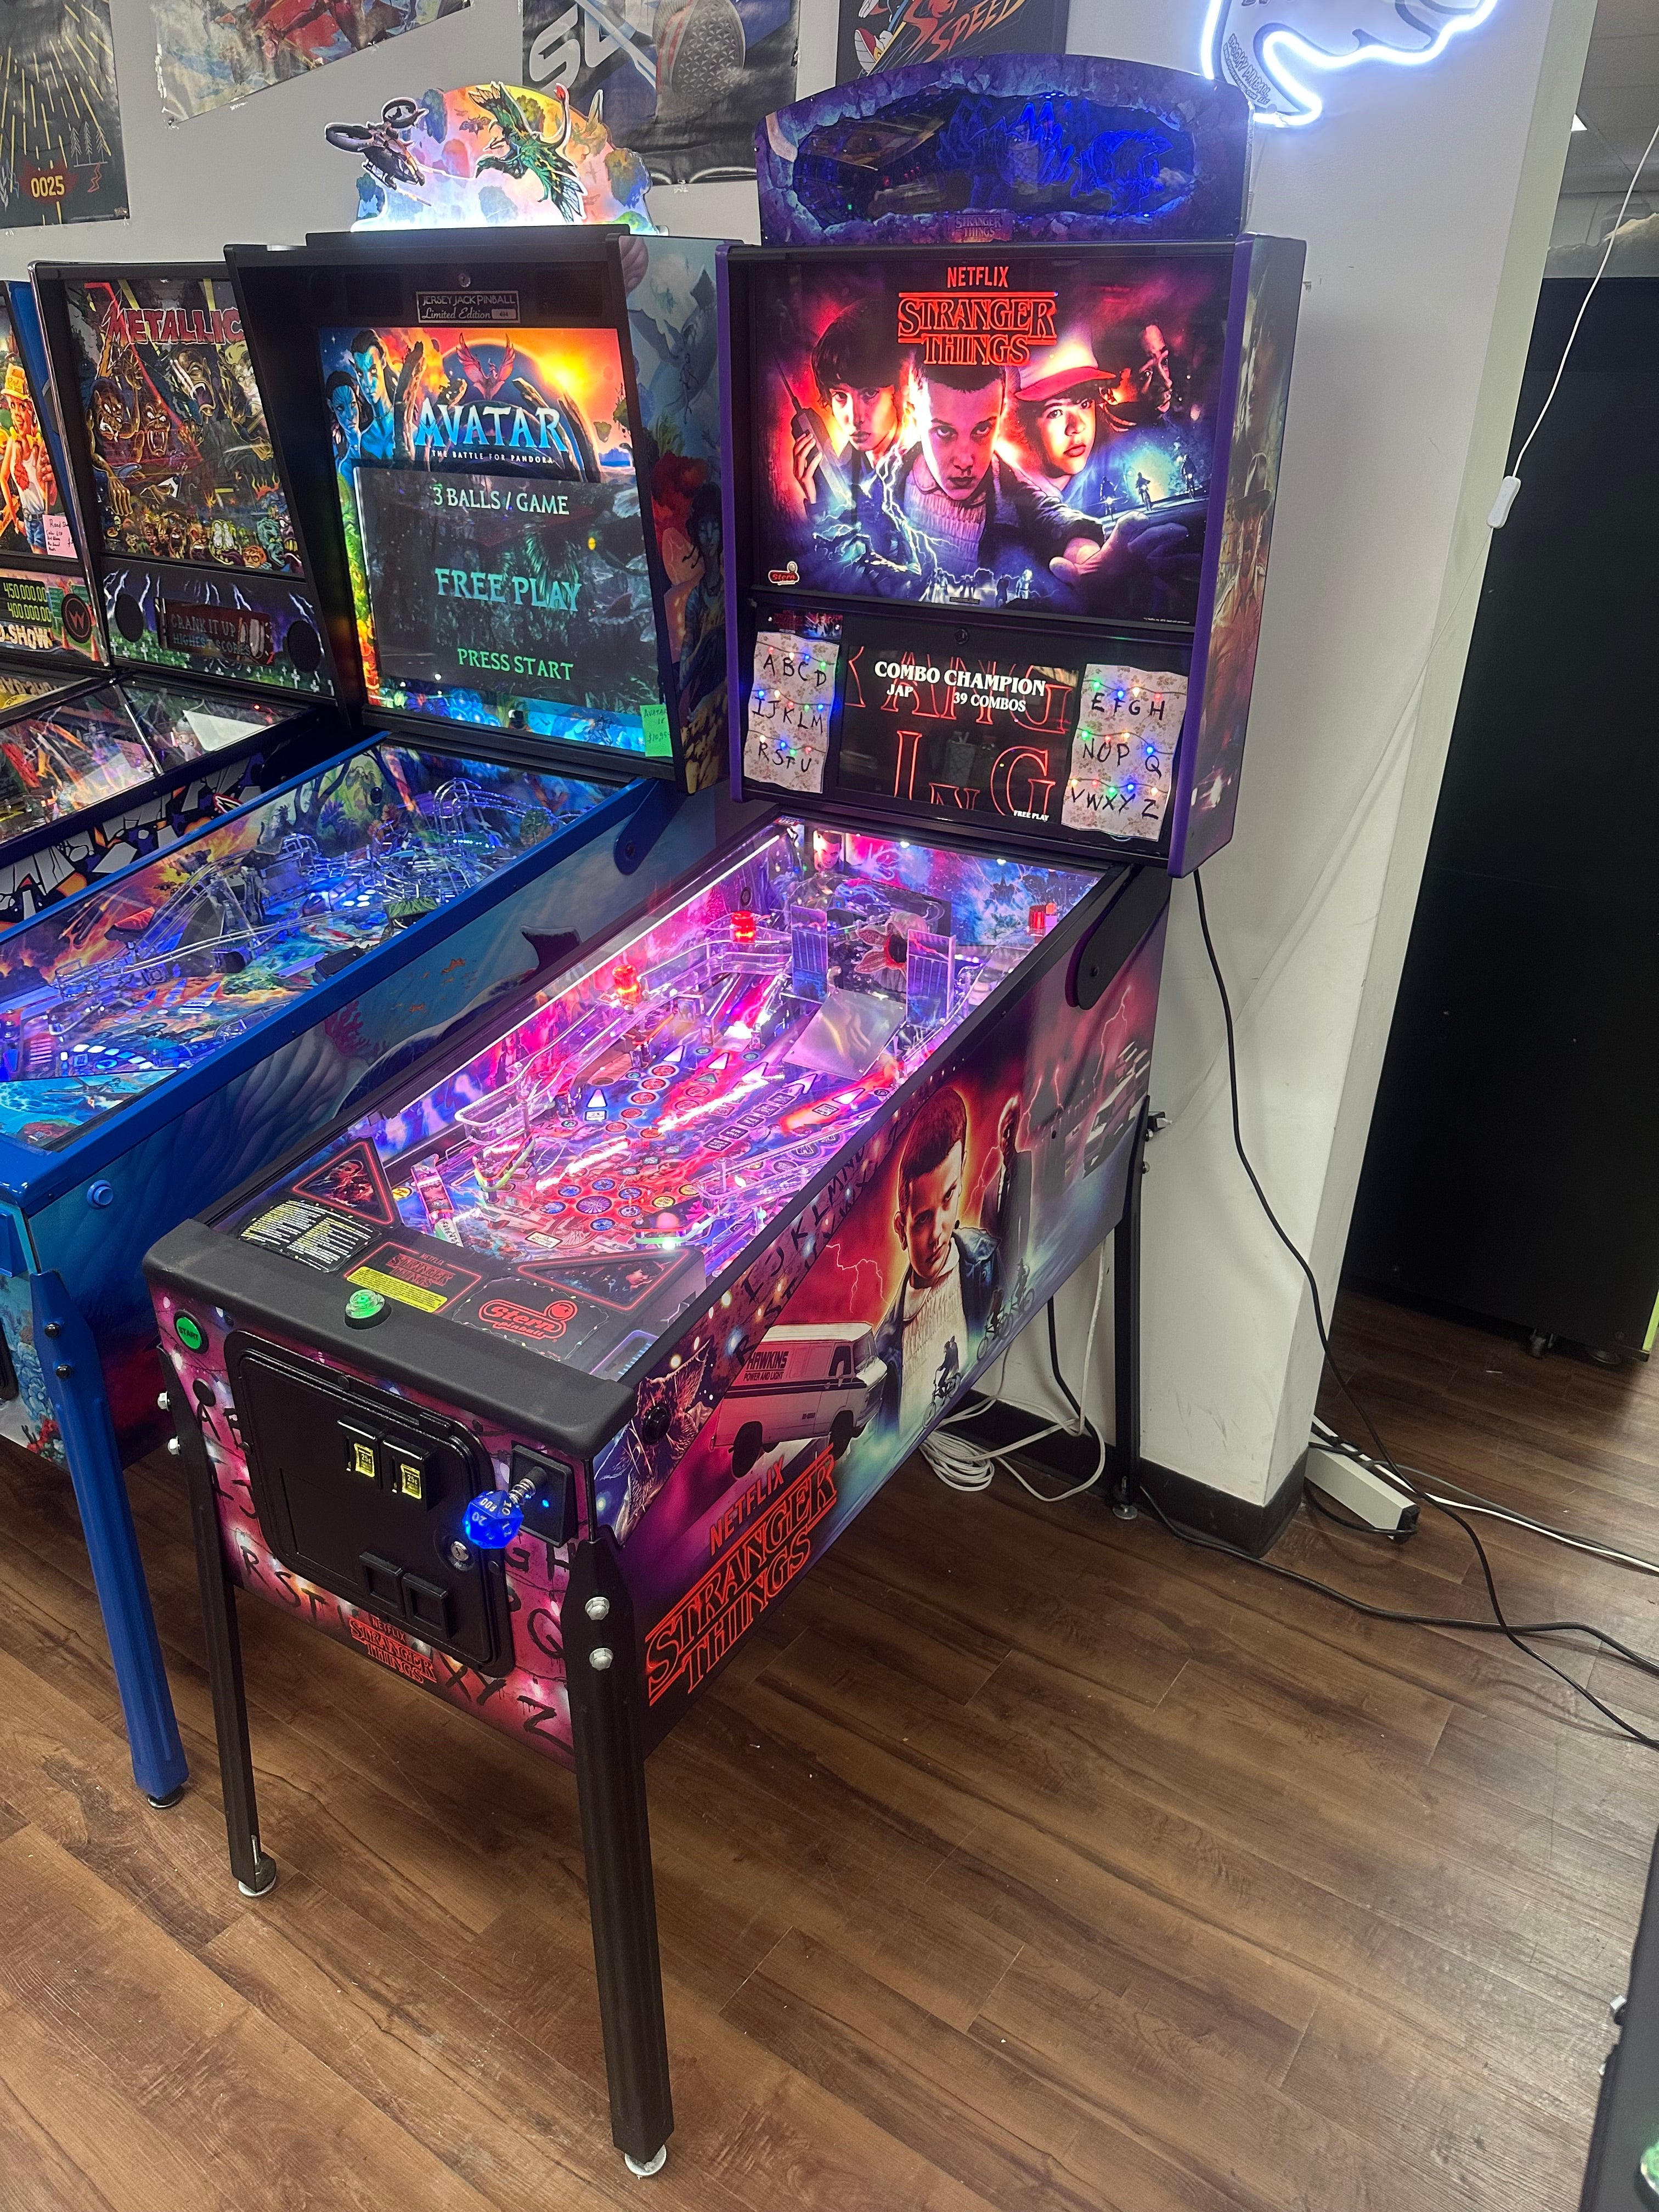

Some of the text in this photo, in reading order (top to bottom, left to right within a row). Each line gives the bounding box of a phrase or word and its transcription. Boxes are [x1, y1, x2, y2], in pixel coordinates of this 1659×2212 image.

[31, 175, 65, 198] 0025
[955, 217, 1001, 229] STRANGER
[964, 227, 995, 238] THINGS
[947, 267, 1009, 289] NETFLIX
[421, 307, 456, 319] Limited
[459, 307, 491, 319] Edition
[422, 295, 516, 306] JERSEY JACK PINBALL
[898, 297, 1058, 338] STRANGER
[922, 333, 1031, 365] THINGS
[414, 397, 568, 452] AVATAR
[432, 449, 554, 465] THE BATTLE FOR PANDORA
[433, 487, 443, 506] 3
[448, 487, 501, 510] BALLS
[516, 493, 570, 516] GAME
[435, 567, 582, 612] FREE PLAY
[8, 623, 52, 650] SHOW
[171, 614, 236, 637] CRANK IT UP
[173, 632, 213, 650] HIGHEST
[458, 647, 574, 681] PRESS START
[874, 661, 1046, 697] COMBO CHAMPION
[887, 684, 1027, 713] JAP 39 COMBOS
[1013, 810, 1049, 822] FREE PLAY
[386, 1254, 455, 1286] STRANGER
[420, 1253, 445, 1266] NETFLIX
[390, 1267, 433, 1288] THINGS
[490, 1306, 556, 1333] Stern
[496, 1321, 545, 1338] pinball
[178, 1326, 199, 1341] START
[747, 1351, 789, 1370] HAWKINS
[743, 1371, 785, 1381] POWER AND LIGHT
[710, 1457, 785, 1555] NETFLIX
[645, 1462, 839, 1681] STRANGER
[684, 1524, 812, 1695] THINGS
[371, 1616, 407, 1643] NETFLIX
[348, 1617, 437, 1682] STRANGER
[366, 1642, 425, 1684] THINGS
